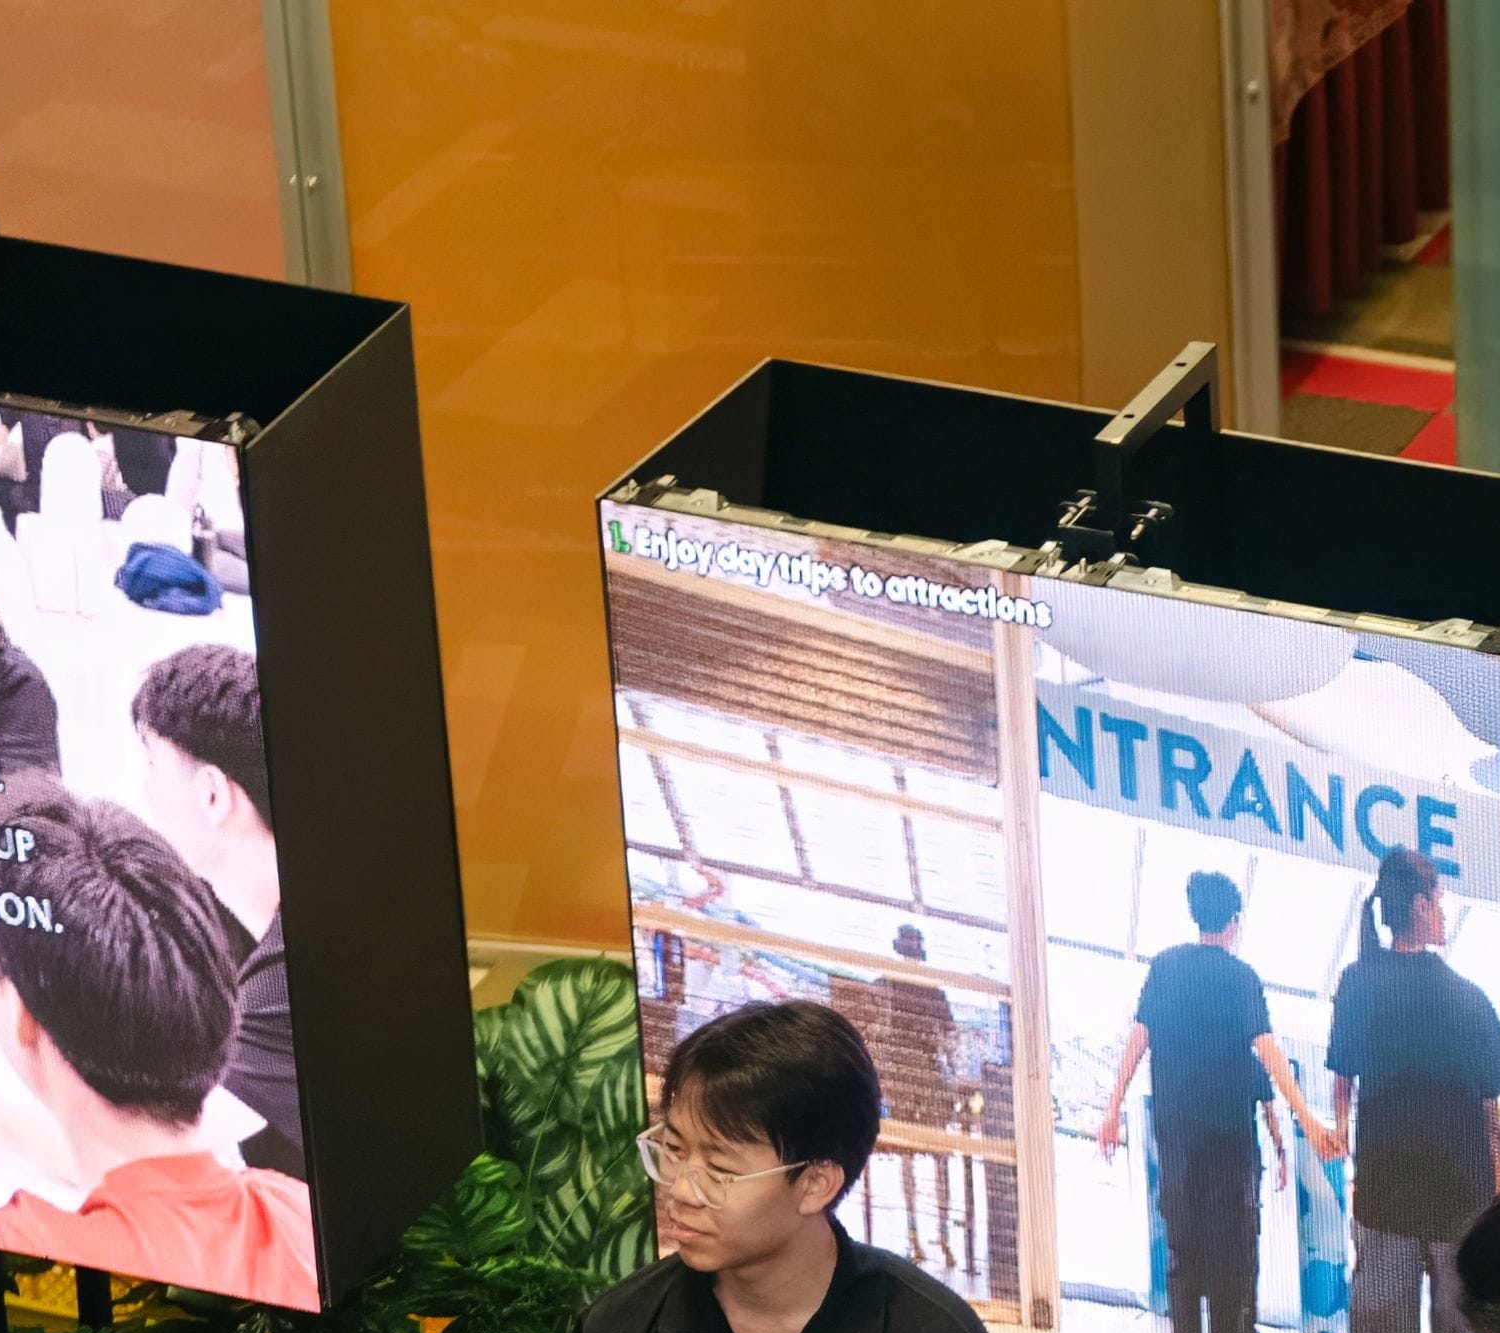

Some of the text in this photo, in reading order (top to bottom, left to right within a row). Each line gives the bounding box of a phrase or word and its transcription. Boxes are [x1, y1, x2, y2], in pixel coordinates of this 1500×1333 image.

[635, 525, 712, 577] Enjoy
[717, 538, 779, 586] day
[777, 556, 848, 597] trips
[850, 566, 883, 598] to
[885, 575, 1053, 630] attractions
